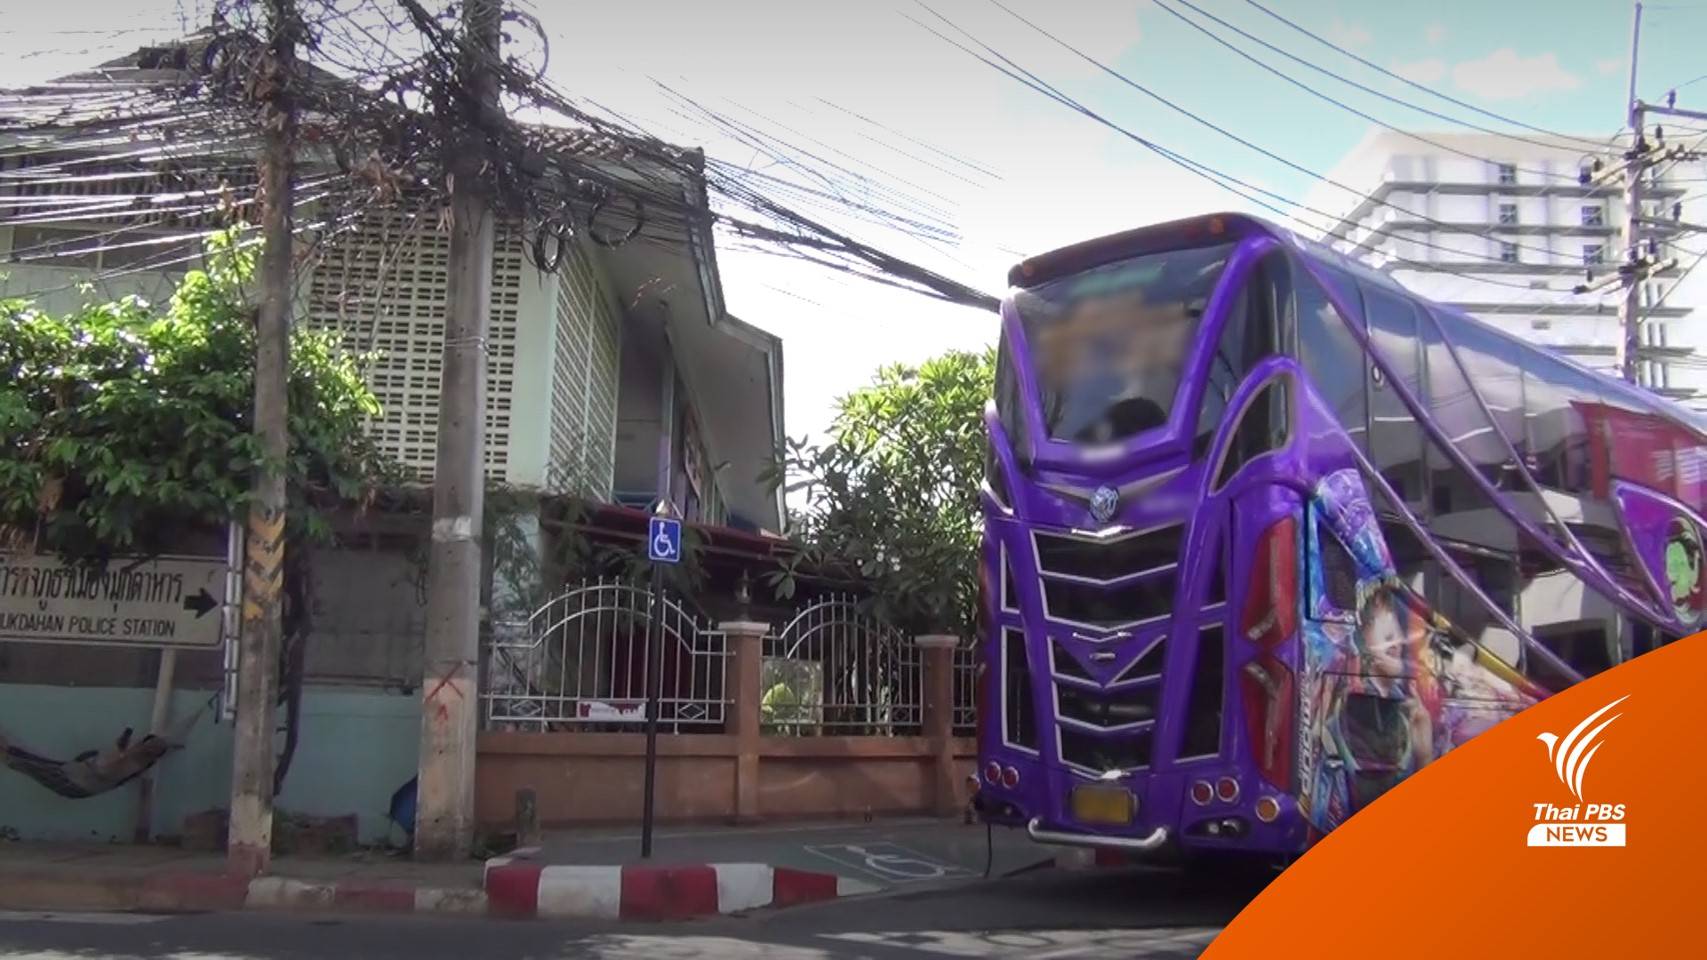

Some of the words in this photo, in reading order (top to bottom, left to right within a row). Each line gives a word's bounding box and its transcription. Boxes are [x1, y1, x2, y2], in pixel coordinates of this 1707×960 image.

[0, 613, 64, 632] UKDAHAN
[68, 616, 117, 635] POLICE
[123, 619, 175, 637] STATION
